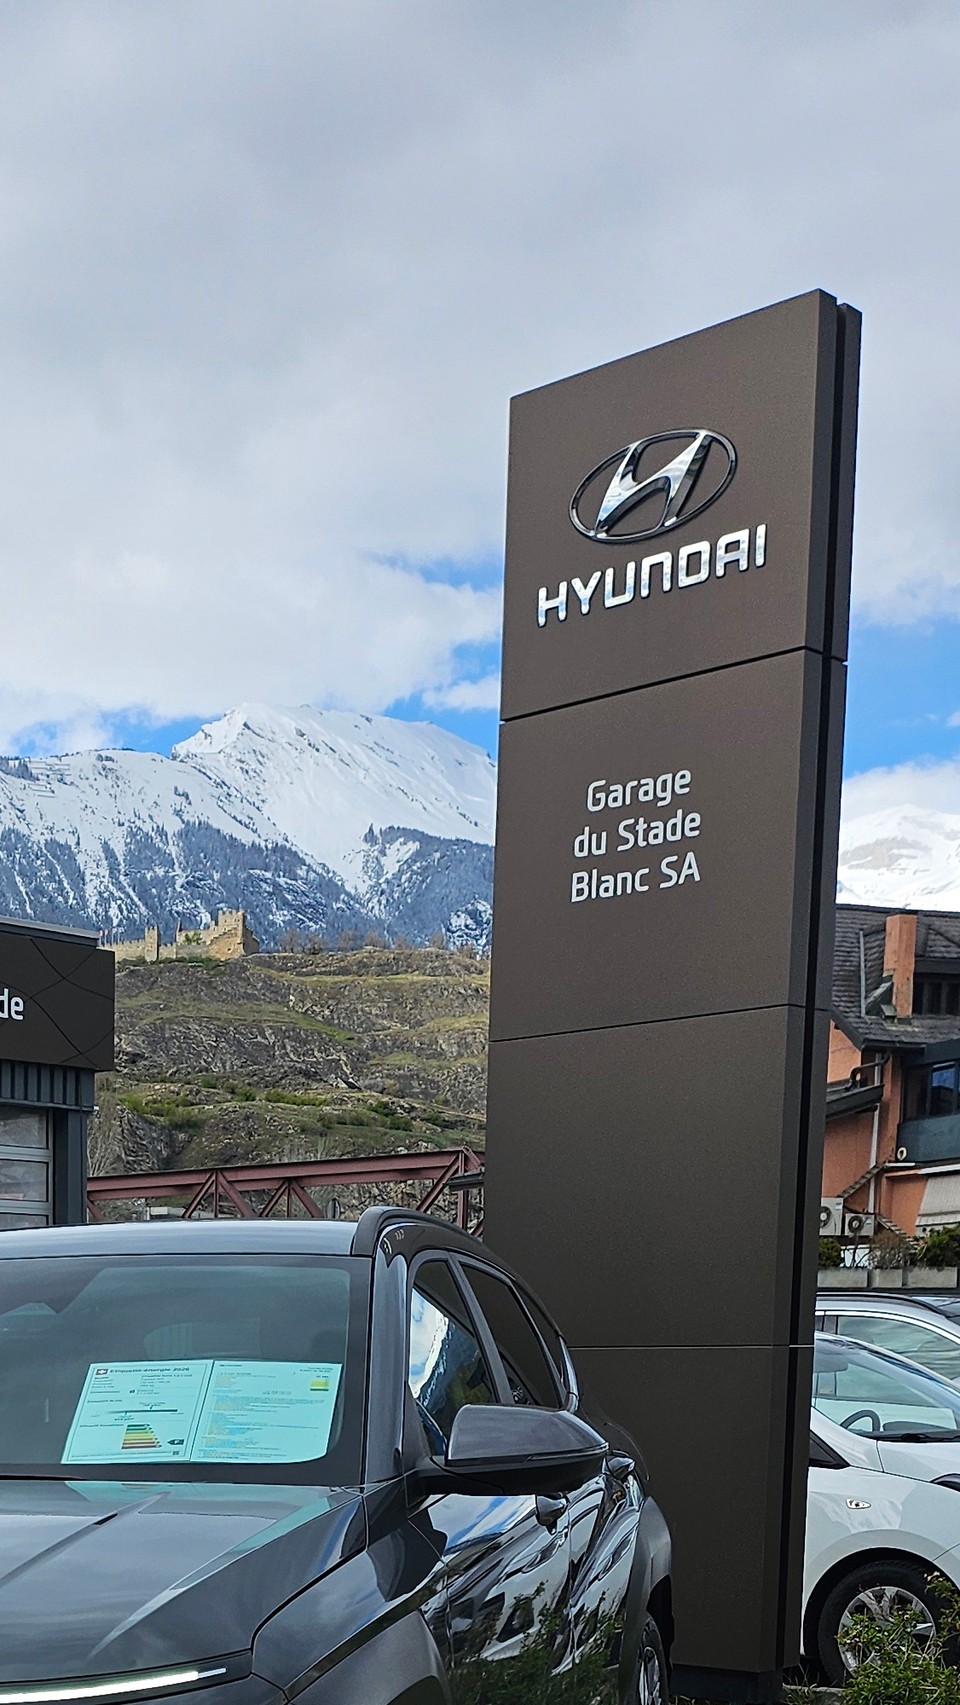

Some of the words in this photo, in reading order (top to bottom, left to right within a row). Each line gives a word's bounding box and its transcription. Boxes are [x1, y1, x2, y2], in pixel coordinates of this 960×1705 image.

[537, 523, 767, 628] HYUNDAI
[587, 769, 692, 812] Garage
[573, 826, 607, 858] du
[617, 808, 701, 852] Stade
[570, 868, 650, 903] Blanc
[659, 851, 701, 889] SA
